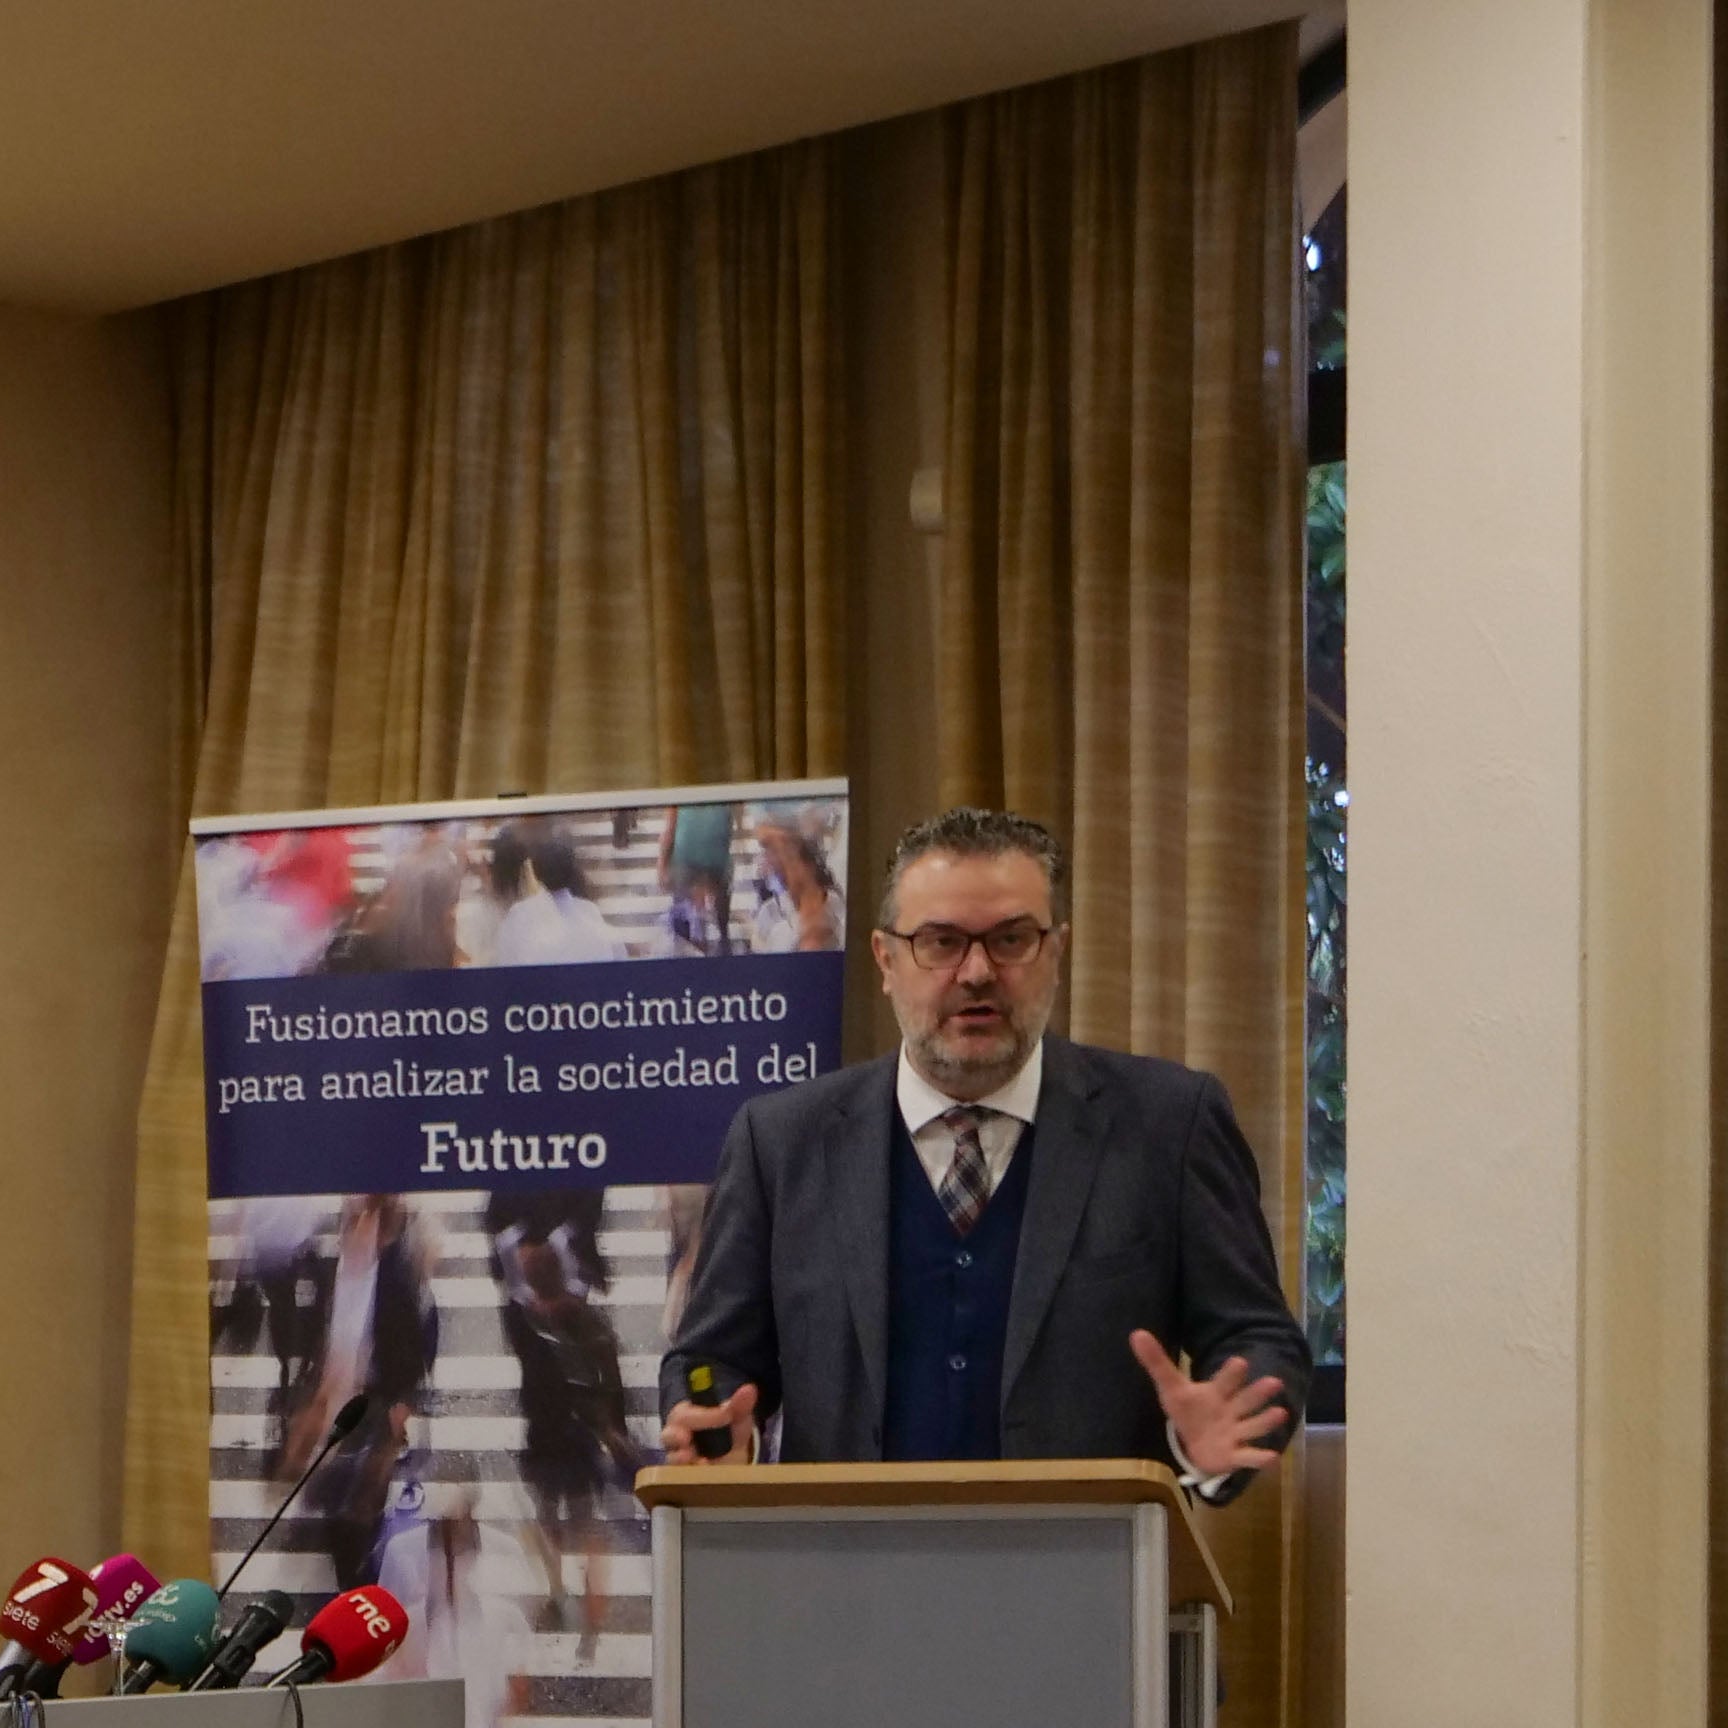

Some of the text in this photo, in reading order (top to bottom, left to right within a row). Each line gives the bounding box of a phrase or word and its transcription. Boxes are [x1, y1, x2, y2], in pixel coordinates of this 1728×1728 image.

[245, 989, 787, 1044] Fusionamos conocimiento
[219, 1042, 816, 1113] para analizar la sociedad del
[419, 1122, 607, 1173] Futuro
[13, 1562, 69, 1603] 7
[3, 1600, 41, 1631] siete
[348, 1593, 391, 1639] rne
